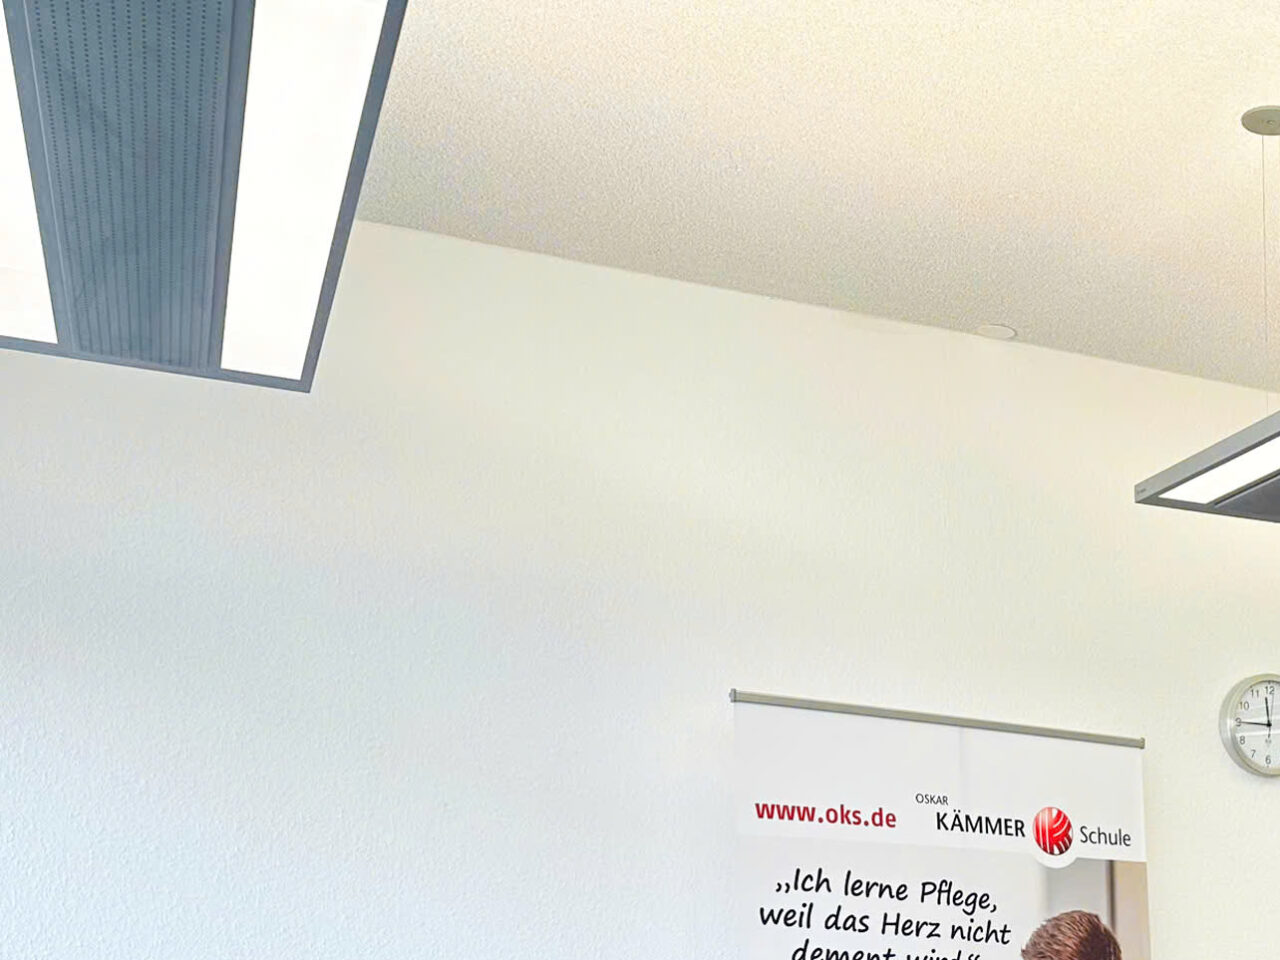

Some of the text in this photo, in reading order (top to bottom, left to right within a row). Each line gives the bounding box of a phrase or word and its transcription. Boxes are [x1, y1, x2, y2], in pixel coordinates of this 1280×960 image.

[1265, 685, 1275, 695] 12
[755, 802, 897, 829] www.oks.de
[915, 793, 949, 806] OSKAR
[936, 810, 1132, 848] KÄMMER Schule
[843, 870, 909, 902] lerne
[920, 881, 999, 914] Pflege,
[759, 903, 1012, 946] weil das Herz nicht
